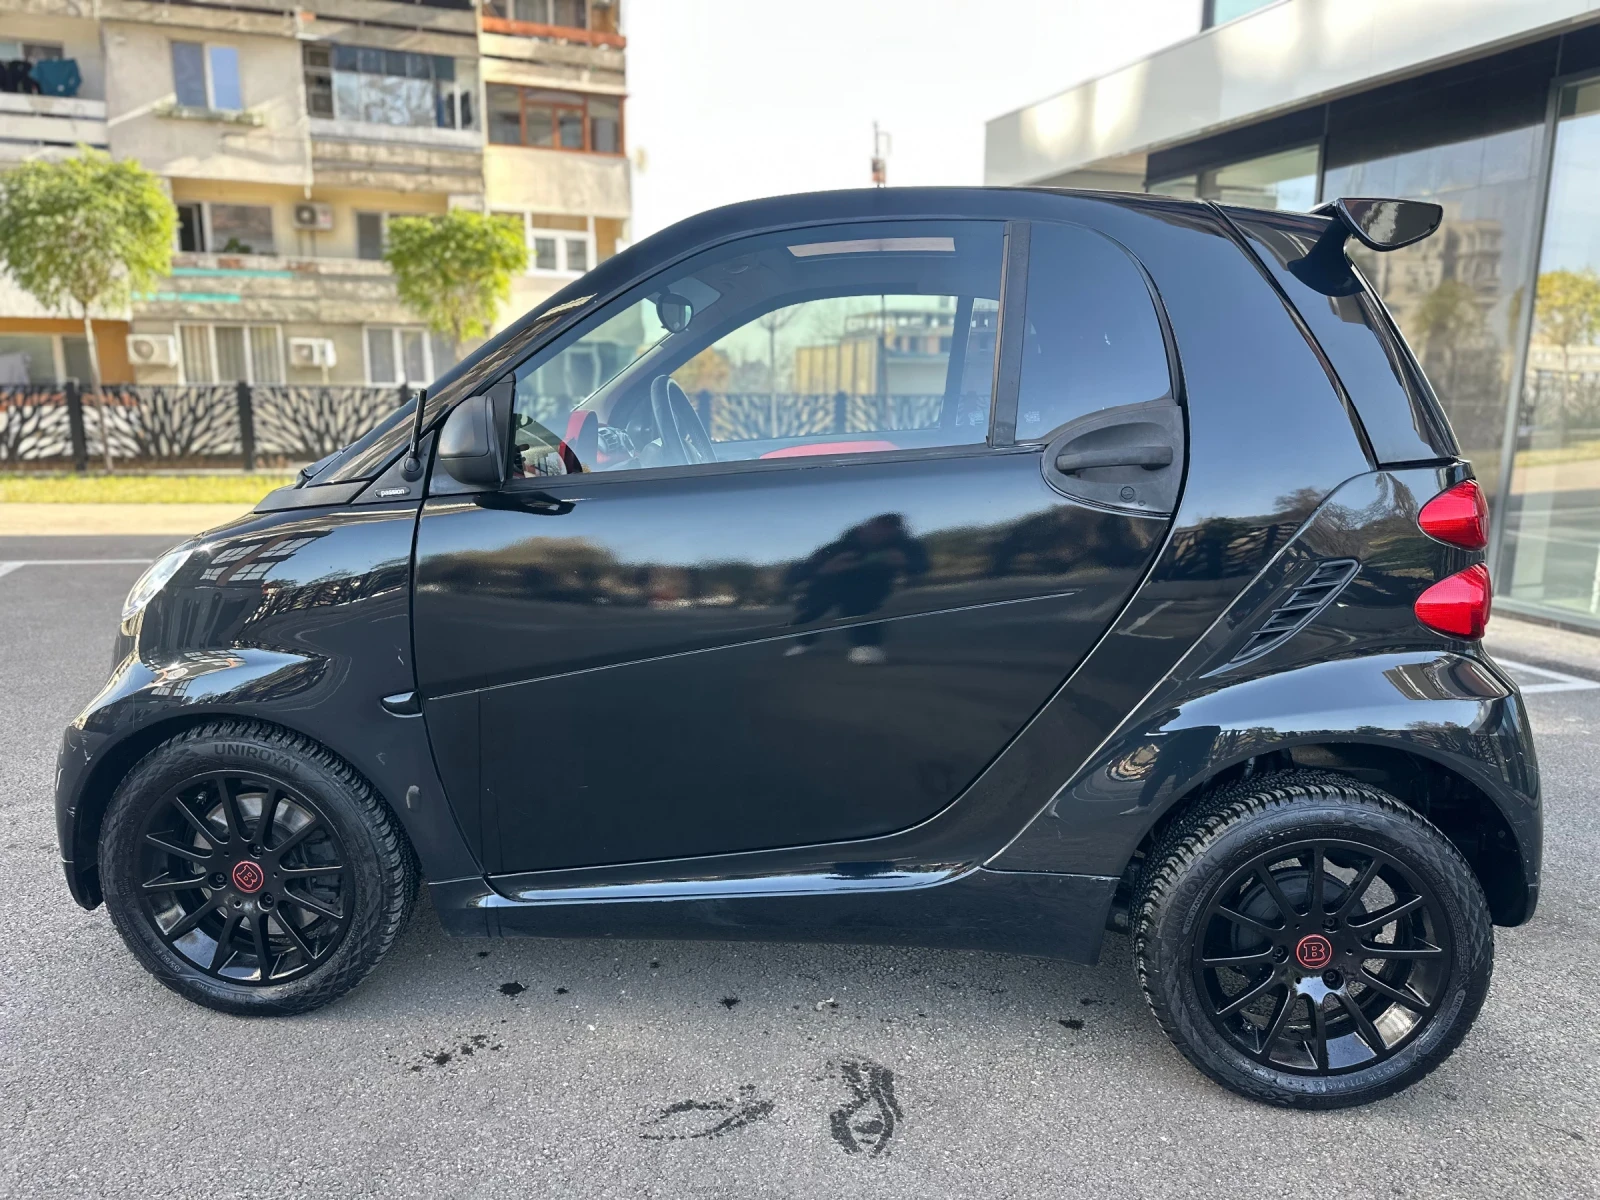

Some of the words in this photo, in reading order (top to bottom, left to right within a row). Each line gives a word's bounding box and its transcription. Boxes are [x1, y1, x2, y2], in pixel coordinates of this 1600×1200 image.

[380, 488, 405, 498] passion
[214, 743, 299, 772] UNIROYAL
[236, 863, 259, 889] B
[1303, 942, 1326, 962] B
